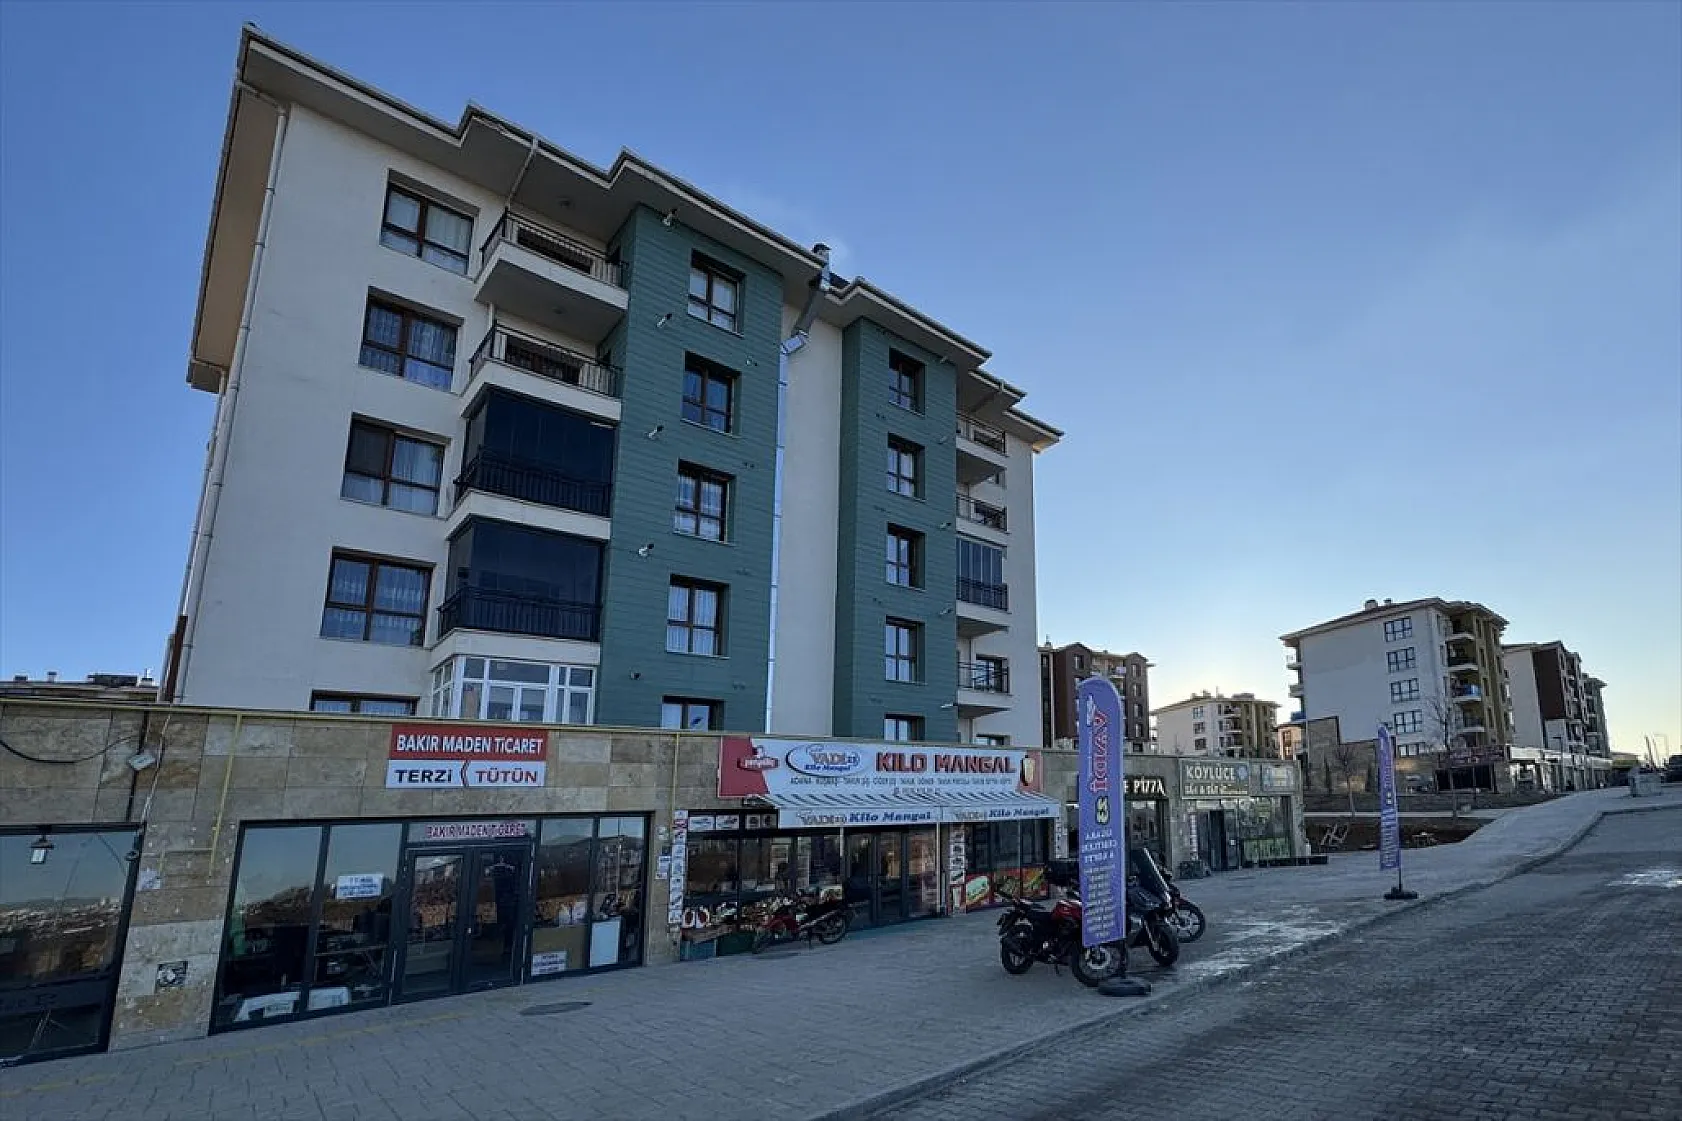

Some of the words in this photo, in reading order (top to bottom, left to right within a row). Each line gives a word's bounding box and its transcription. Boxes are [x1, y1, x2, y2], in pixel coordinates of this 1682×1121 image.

[397, 734, 439, 751] BAKIR
[443, 735, 490, 753] MADEN
[495, 736, 543, 754] TİCARET
[876, 752, 927, 774] KILO
[934, 754, 1016, 774] MANGAL
[395, 769, 452, 784] TERZİ
[475, 767, 537, 784] TÜTÜN
[849, 811, 878, 822] Kilo
[882, 811, 931, 822] Mangal
[989, 809, 1011, 818] Kilo
[1014, 807, 1049, 817] Mangal
